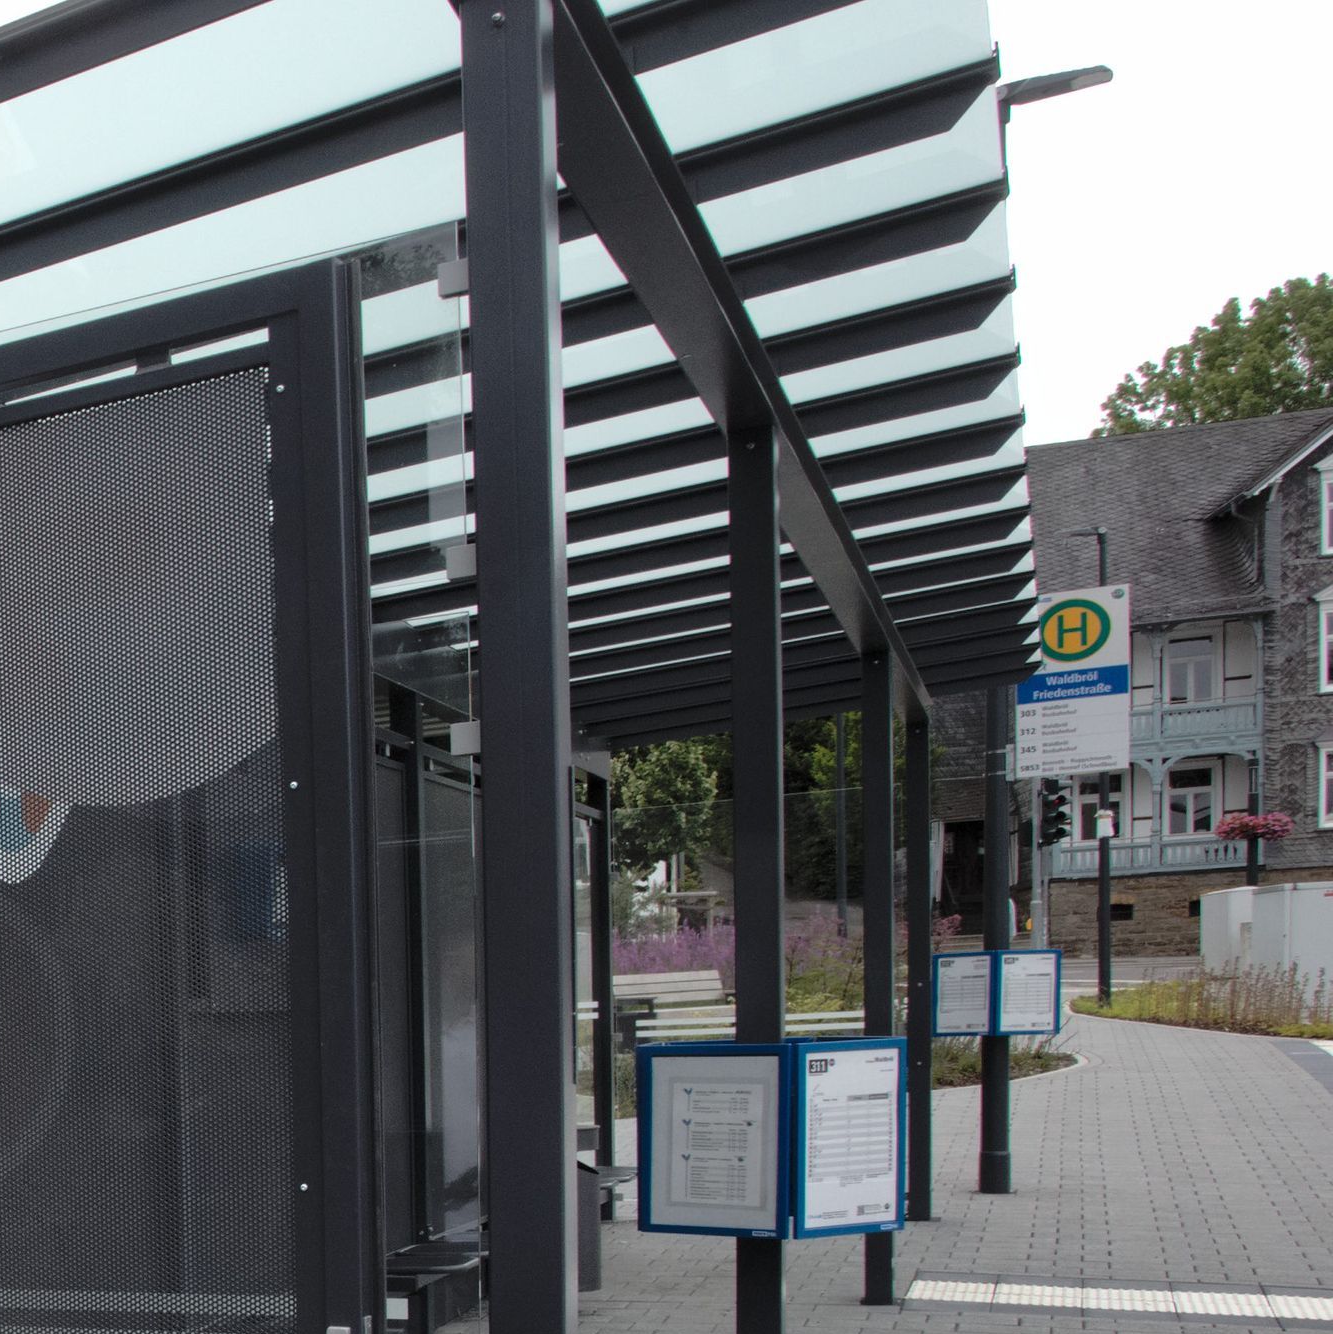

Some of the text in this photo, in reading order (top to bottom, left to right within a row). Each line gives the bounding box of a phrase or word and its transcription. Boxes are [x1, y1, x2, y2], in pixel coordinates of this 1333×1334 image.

[1057, 611, 1088, 649] H
[1045, 671, 1099, 686] Waldbröl
[1033, 683, 1112, 700] Friedenstraße
[1020, 709, 1037, 718] 303
[1019, 728, 1036, 736] 312
[1020, 746, 1037, 754] 345
[810, 1060, 827, 1072] 311
